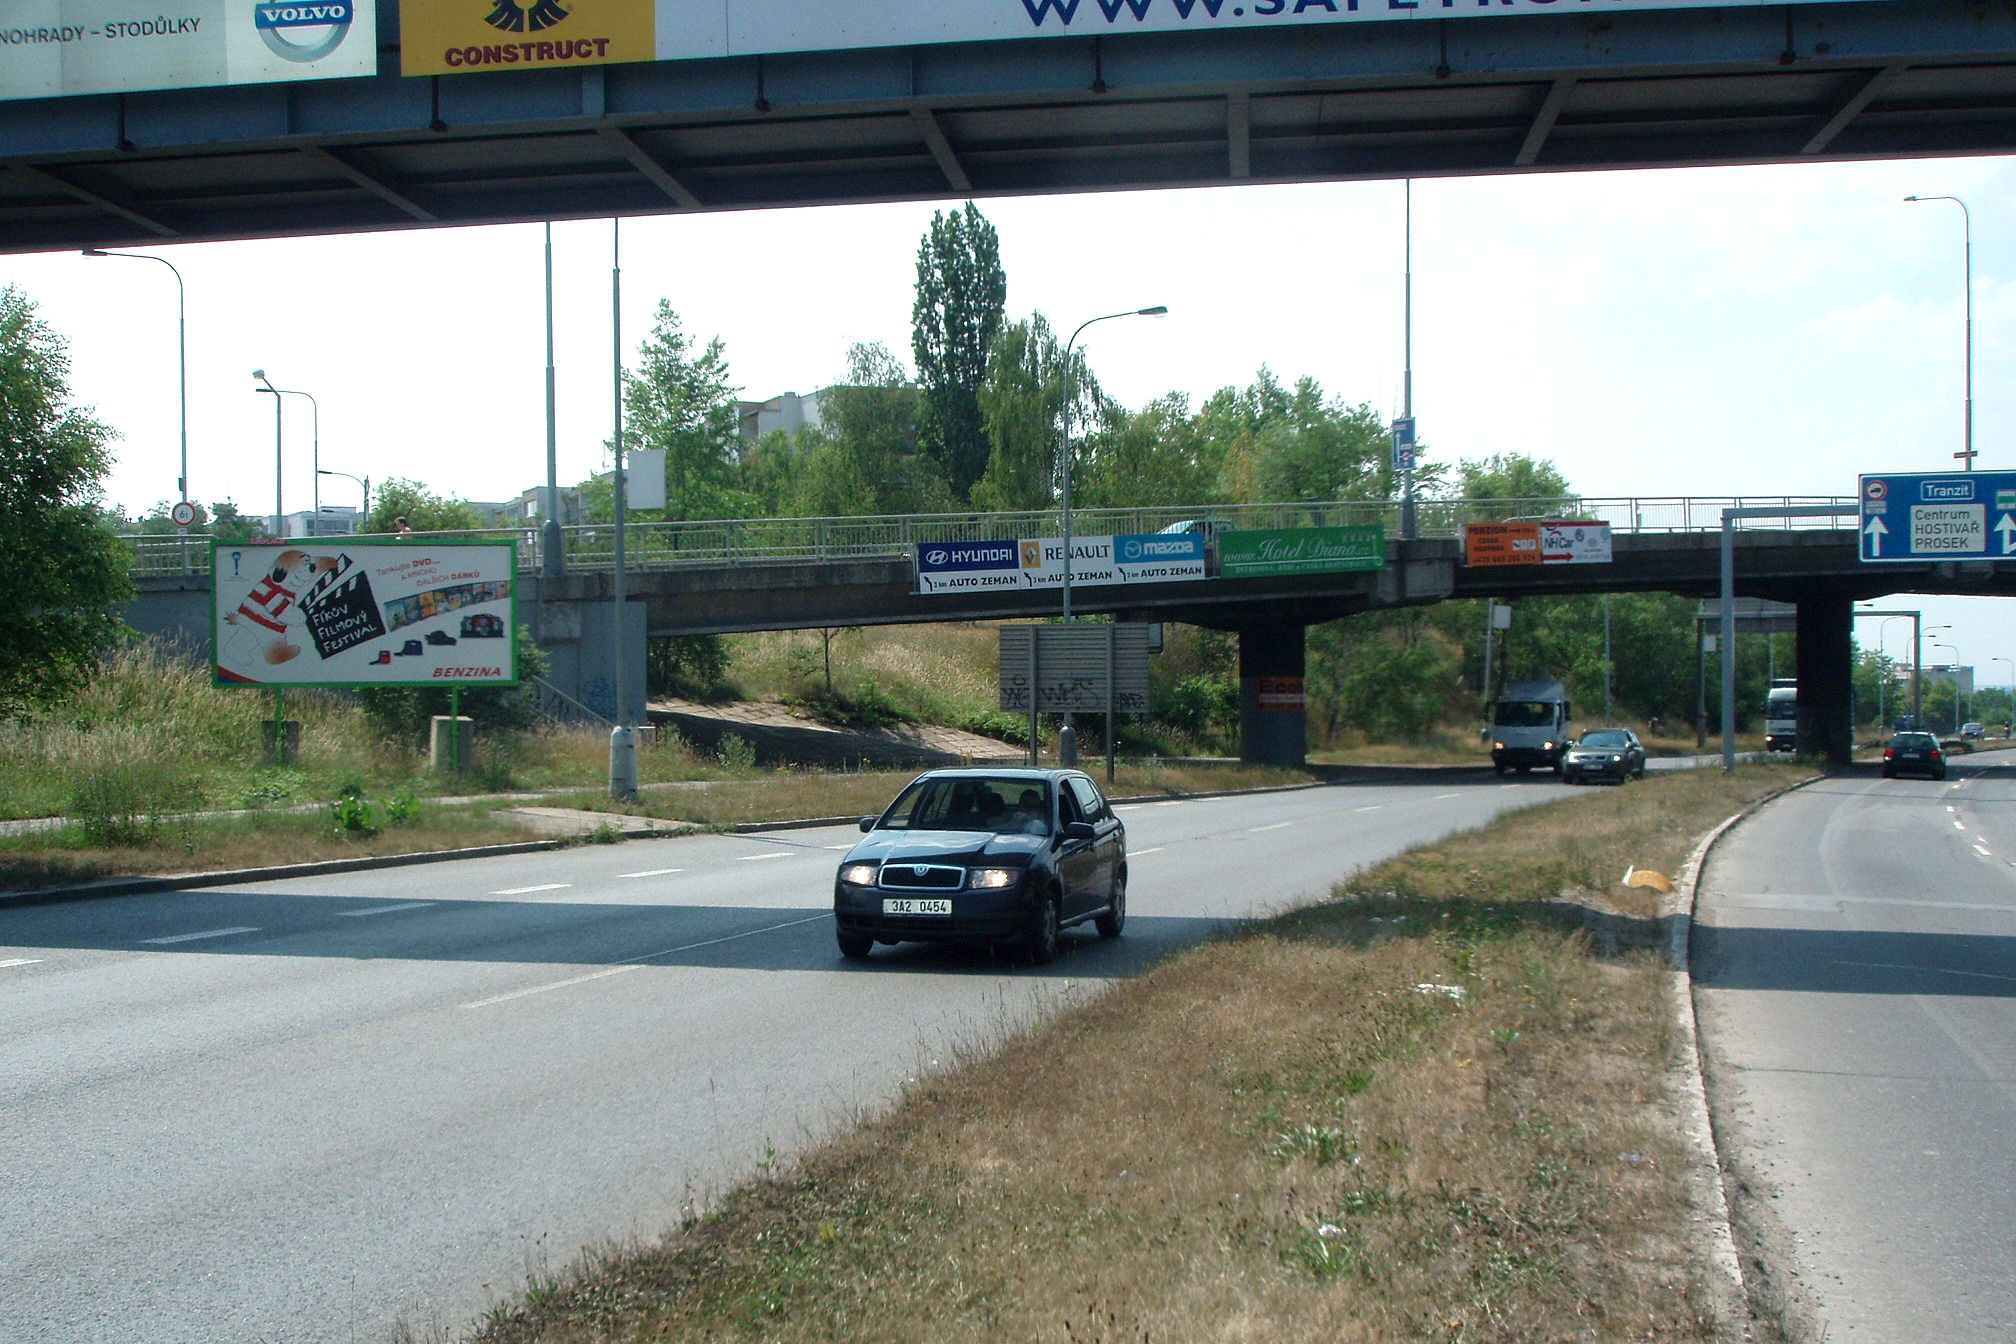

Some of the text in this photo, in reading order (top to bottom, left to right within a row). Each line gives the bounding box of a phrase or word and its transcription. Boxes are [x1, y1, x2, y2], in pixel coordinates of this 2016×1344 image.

[262, 4, 346, 22] VOLVO
[105, 16, 201, 39] STODŮLKY
[445, 38, 610, 67] CONSTRUCT
[1926, 484, 1969, 497] Tranzit
[1915, 509, 1970, 520] Centrum
[1915, 521, 1980, 535] HOSTIVAŘ
[1915, 537, 1969, 549] PROSEK
[951, 549, 1012, 563] HYUNDAI
[1045, 544, 1111, 561] RENAULT
[1048, 573, 1075, 583] AUO
[1077, 571, 1113, 581] ZEMAN
[1141, 568, 1167, 578] AUTO
[1169, 566, 1202, 576] ZEMAN
[949, 577, 978, 587] AUTO
[981, 576, 1017, 586] ZEMAN
[317, 610, 368, 640] FILMOVÝ
[323, 623, 378, 653] FESTIVAL
[432, 667, 502, 678] BENZINA
[892, 900, 947, 913] 3A2 0454
